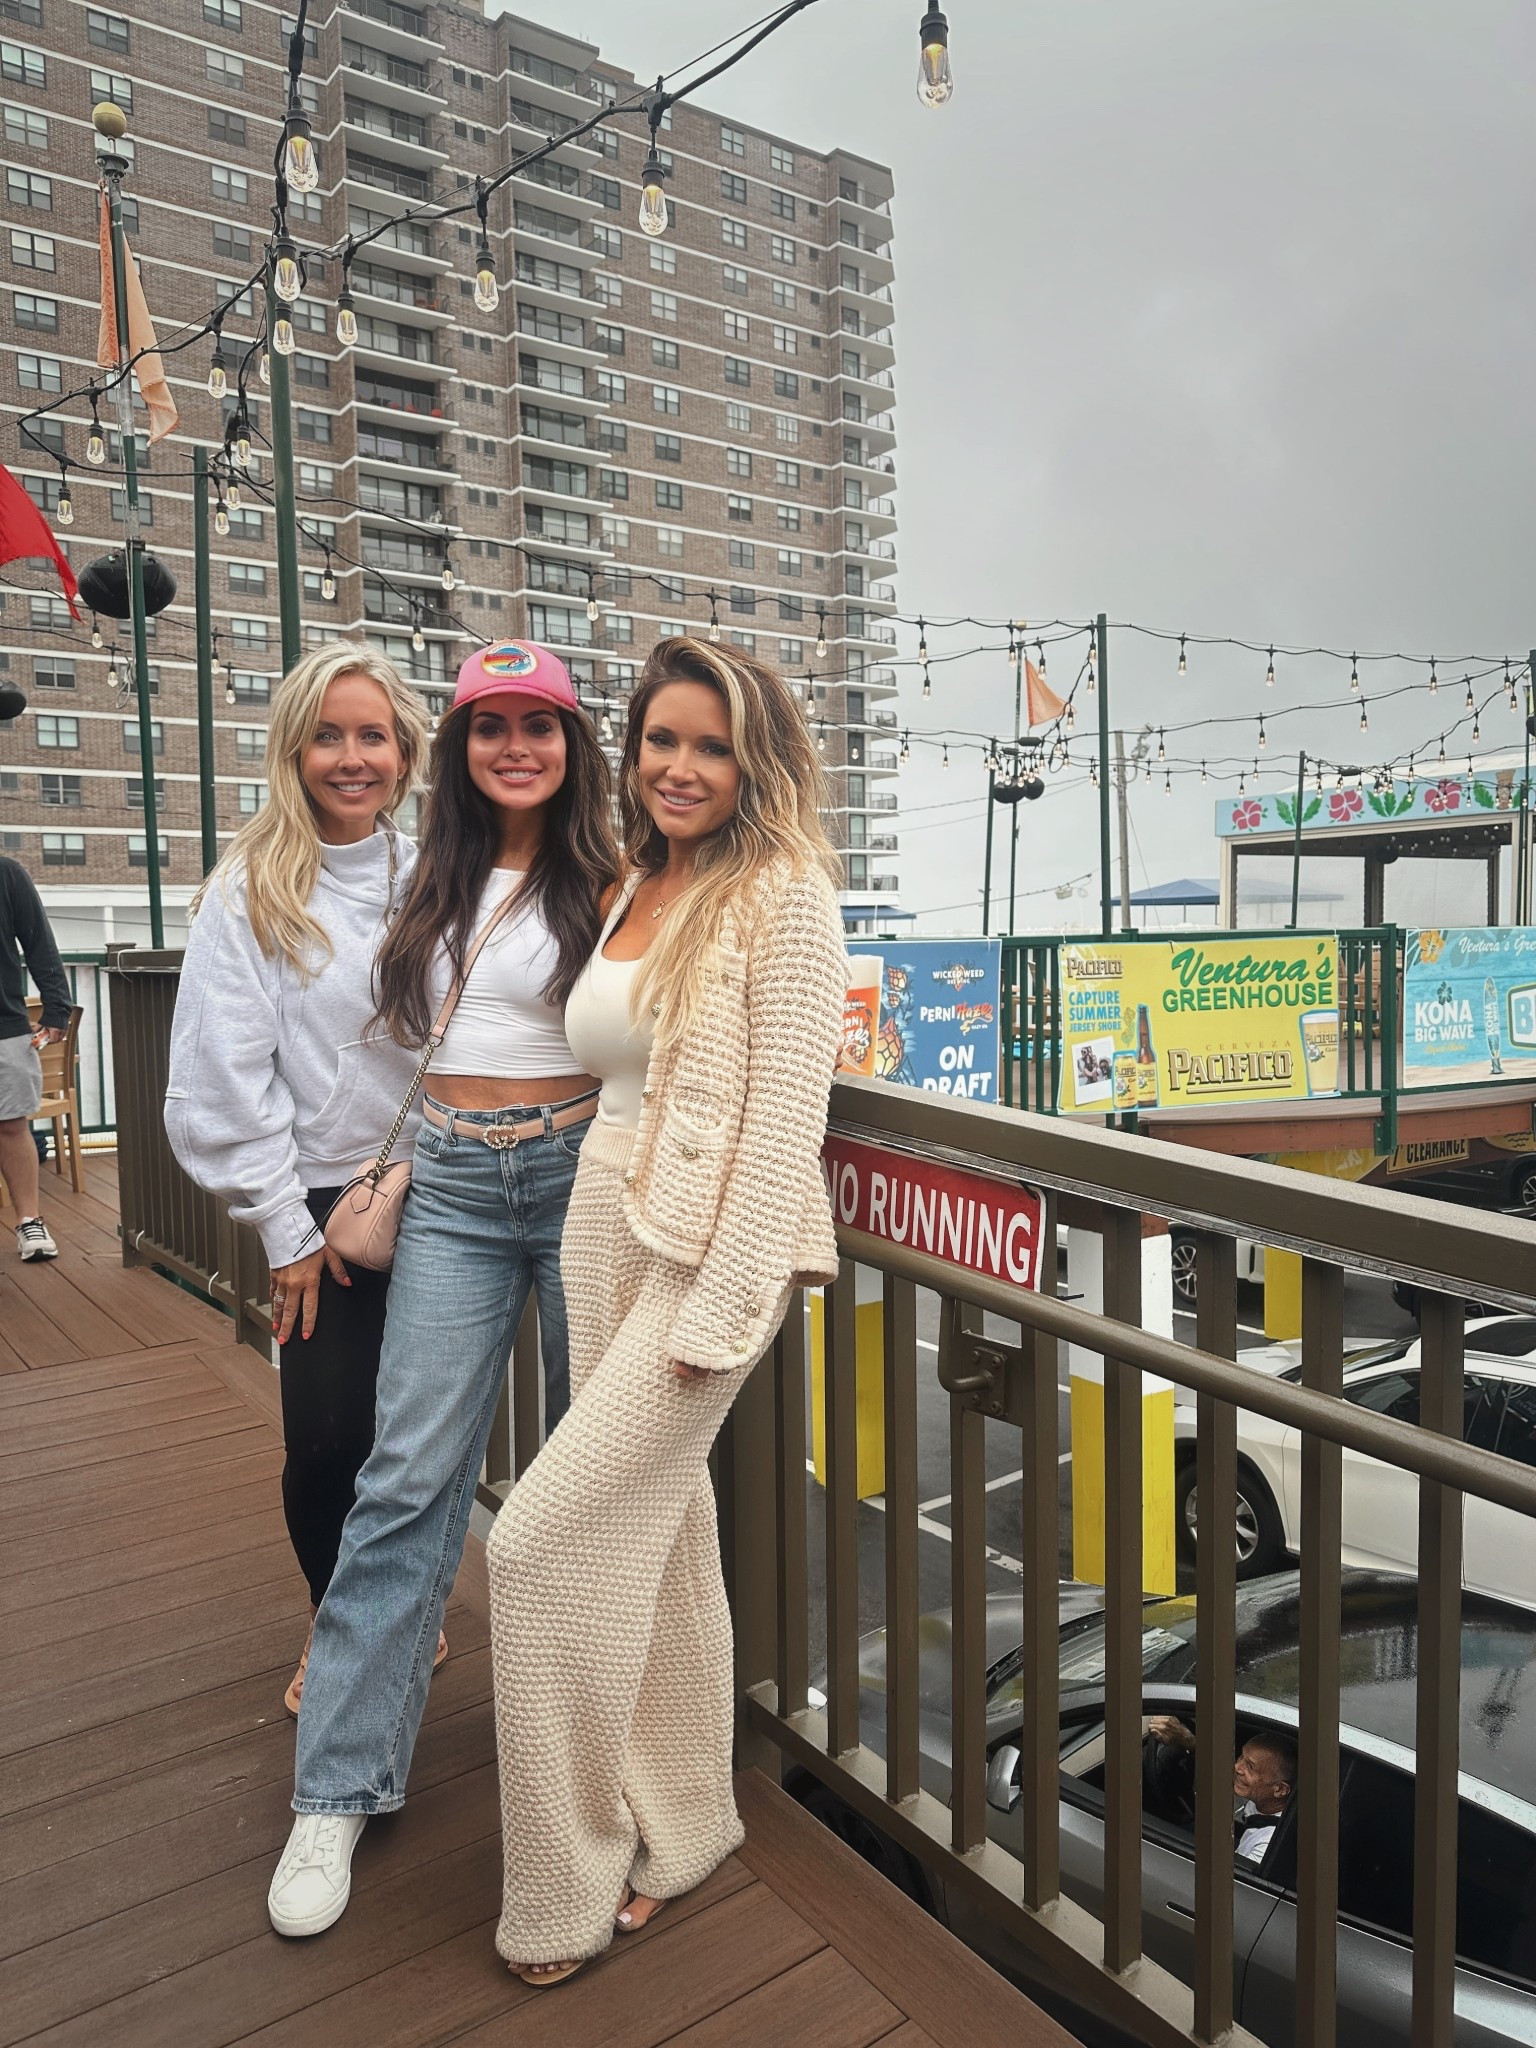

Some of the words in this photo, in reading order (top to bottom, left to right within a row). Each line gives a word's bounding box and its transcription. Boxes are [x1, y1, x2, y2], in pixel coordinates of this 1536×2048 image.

[1458, 934, 1510, 954] Ventura's
[932, 969, 963, 980] WICKED
[963, 969, 985, 979] WEED
[1171, 942, 1334, 988] Ventura's
[1068, 990, 1120, 1006] CAPTURE
[1162, 981, 1333, 1013] GREENHOUSE
[1069, 1006, 1121, 1022] SUMMER
[1415, 999, 1473, 1027] KONA
[1069, 1022, 1096, 1033] JERSEY
[1098, 1021, 1121, 1030] SHORE
[1439, 1024, 1475, 1041] WAVE
[1205, 1040, 1291, 1051] CERVEZA
[939, 1045, 975, 1072] ON
[1167, 1048, 1294, 1091] PACIFICO
[1406, 1138, 1466, 1164] CLEARANCE
[821, 1156, 859, 1225] NO
[868, 1171, 1031, 1284] RUNNING
